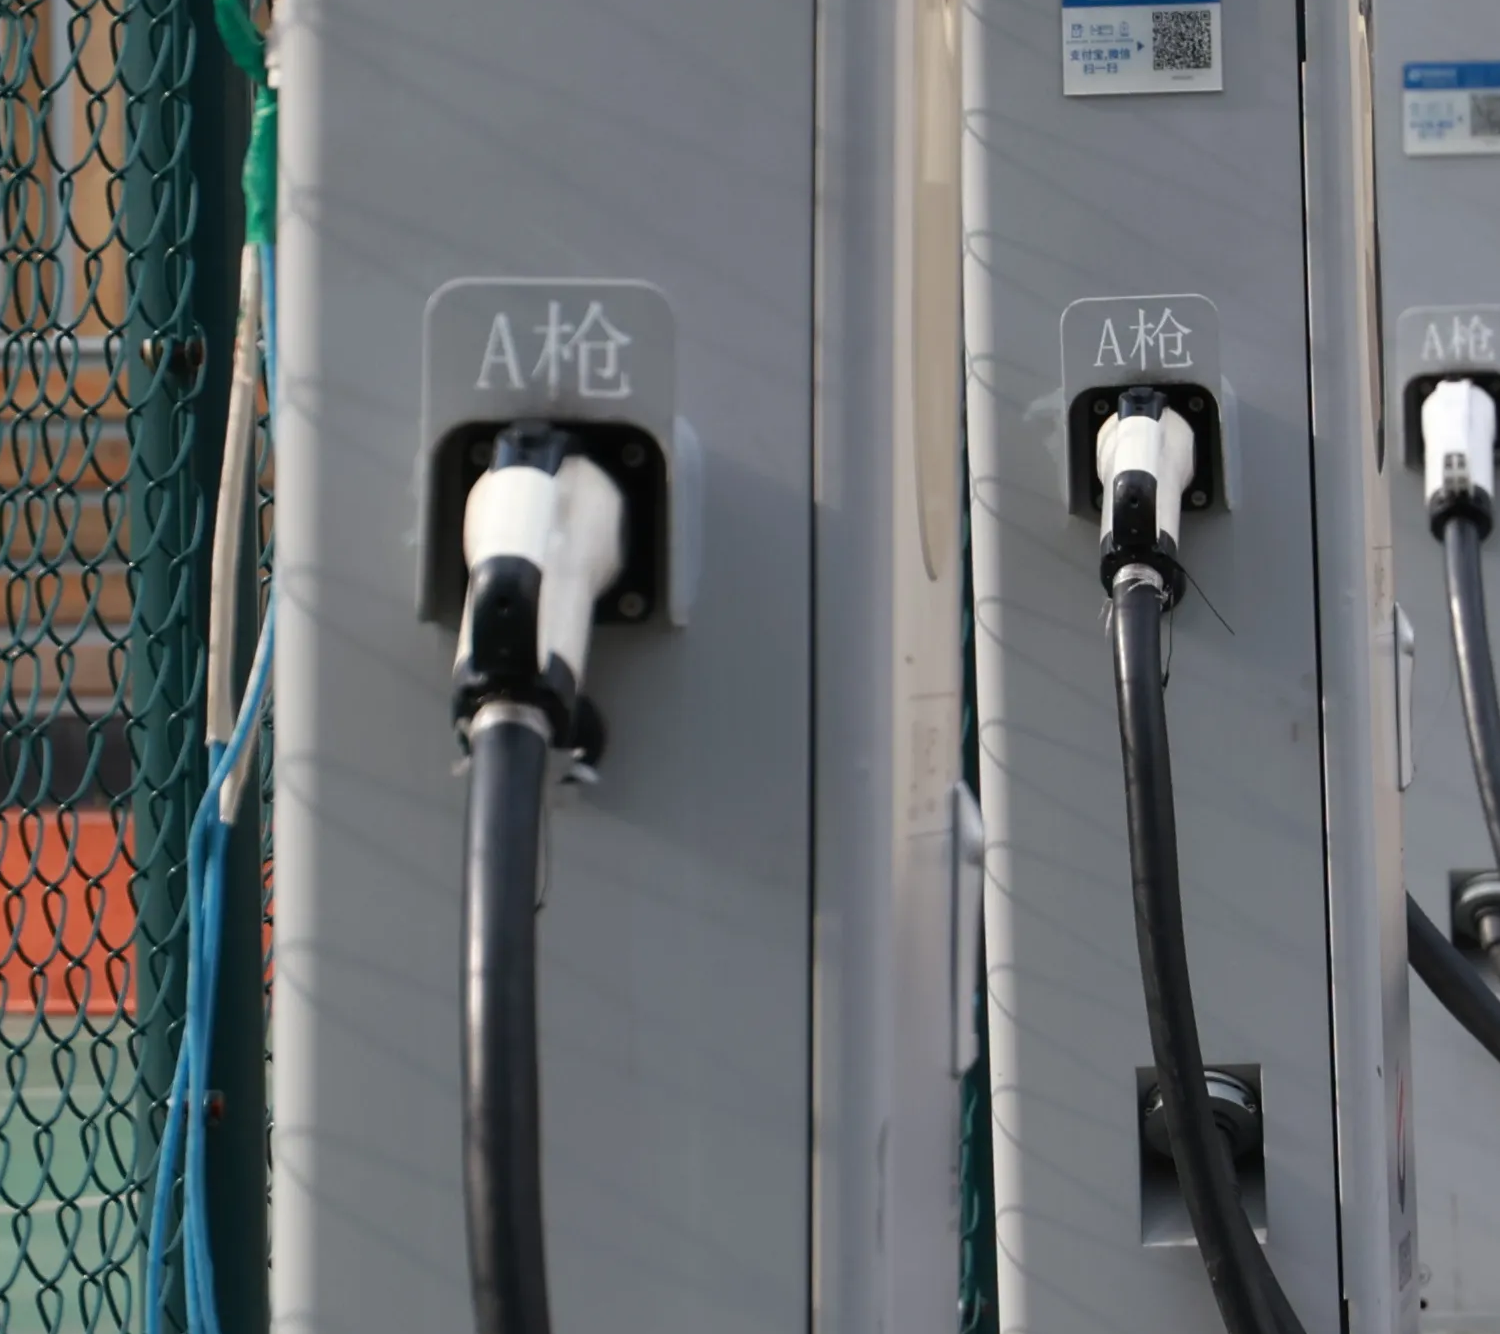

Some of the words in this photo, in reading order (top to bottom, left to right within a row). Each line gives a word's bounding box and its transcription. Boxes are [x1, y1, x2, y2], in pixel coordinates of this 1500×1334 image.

[473, 299, 632, 401] A枪
[1093, 307, 1194, 372] A枪
[1419, 314, 1497, 363] A枪
